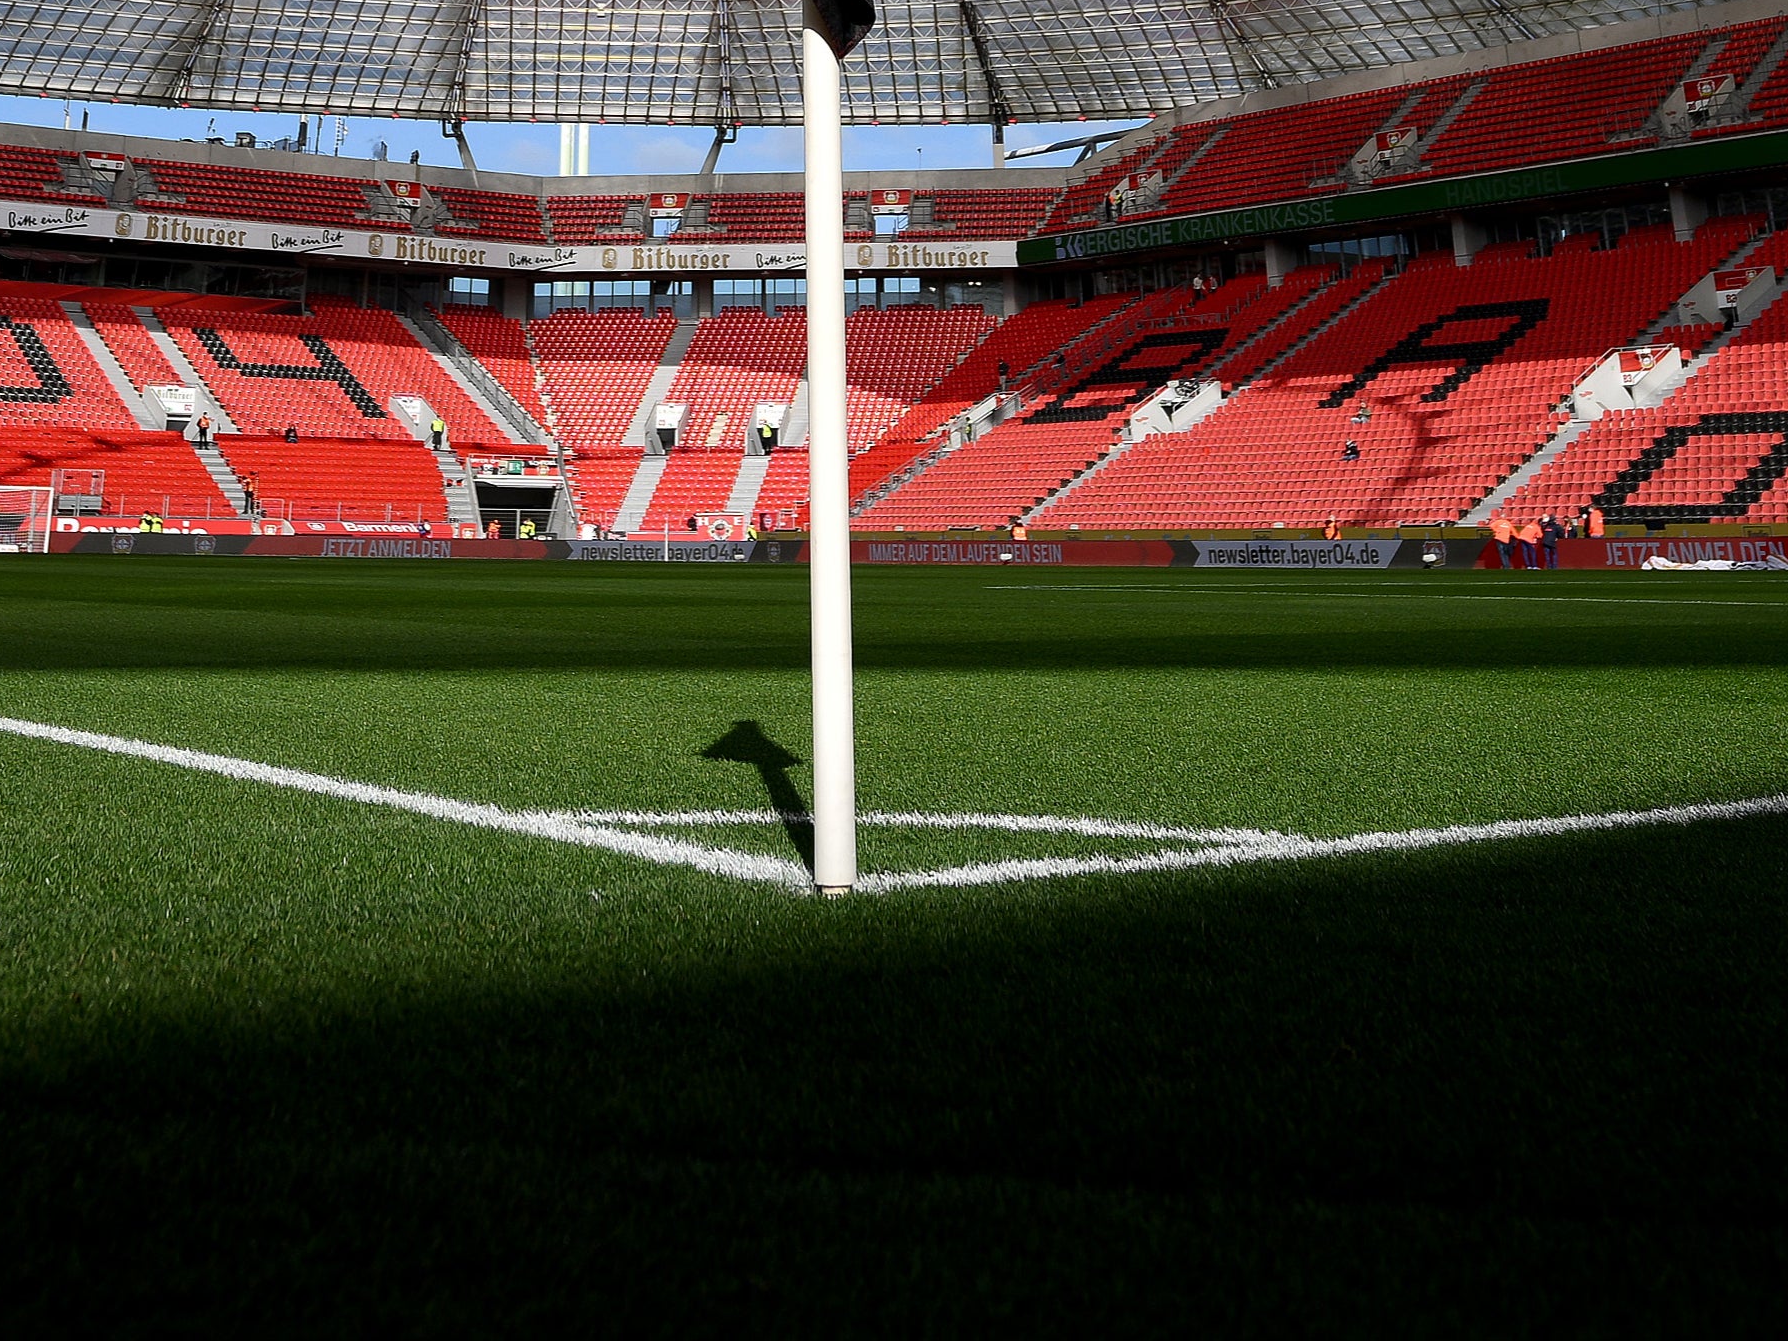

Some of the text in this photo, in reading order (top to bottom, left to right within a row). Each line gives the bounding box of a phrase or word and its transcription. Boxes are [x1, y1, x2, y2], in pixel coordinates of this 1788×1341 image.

[1444, 168, 1571, 207] HANDSPIEL
[8, 211, 37, 228] Bitte
[40, 214, 63, 224] ein
[65, 208, 91, 224] Bit
[1075, 199, 1336, 257] BERGISCHE KRANKENKASSE
[143, 215, 345, 249] Bitburger Bitte ein Bit
[394, 235, 578, 267] Bitburger Bitte ein Bit
[631, 247, 731, 269] Bitburger
[756, 252, 784, 269] Bitte
[886, 244, 989, 268] Bitburger
[342, 521, 420, 533] Barmeni
[321, 538, 452, 559] JETZT ANMELDEN
[581, 543, 744, 561] newsletter.bayer04.de
[869, 543, 1063, 563] IMMER AUF DEM LAUFENDEN SEIN
[1208, 543, 1380, 567] newsletter.bayer04.de
[1605, 540, 1786, 566] JETZT ANMELDEN
